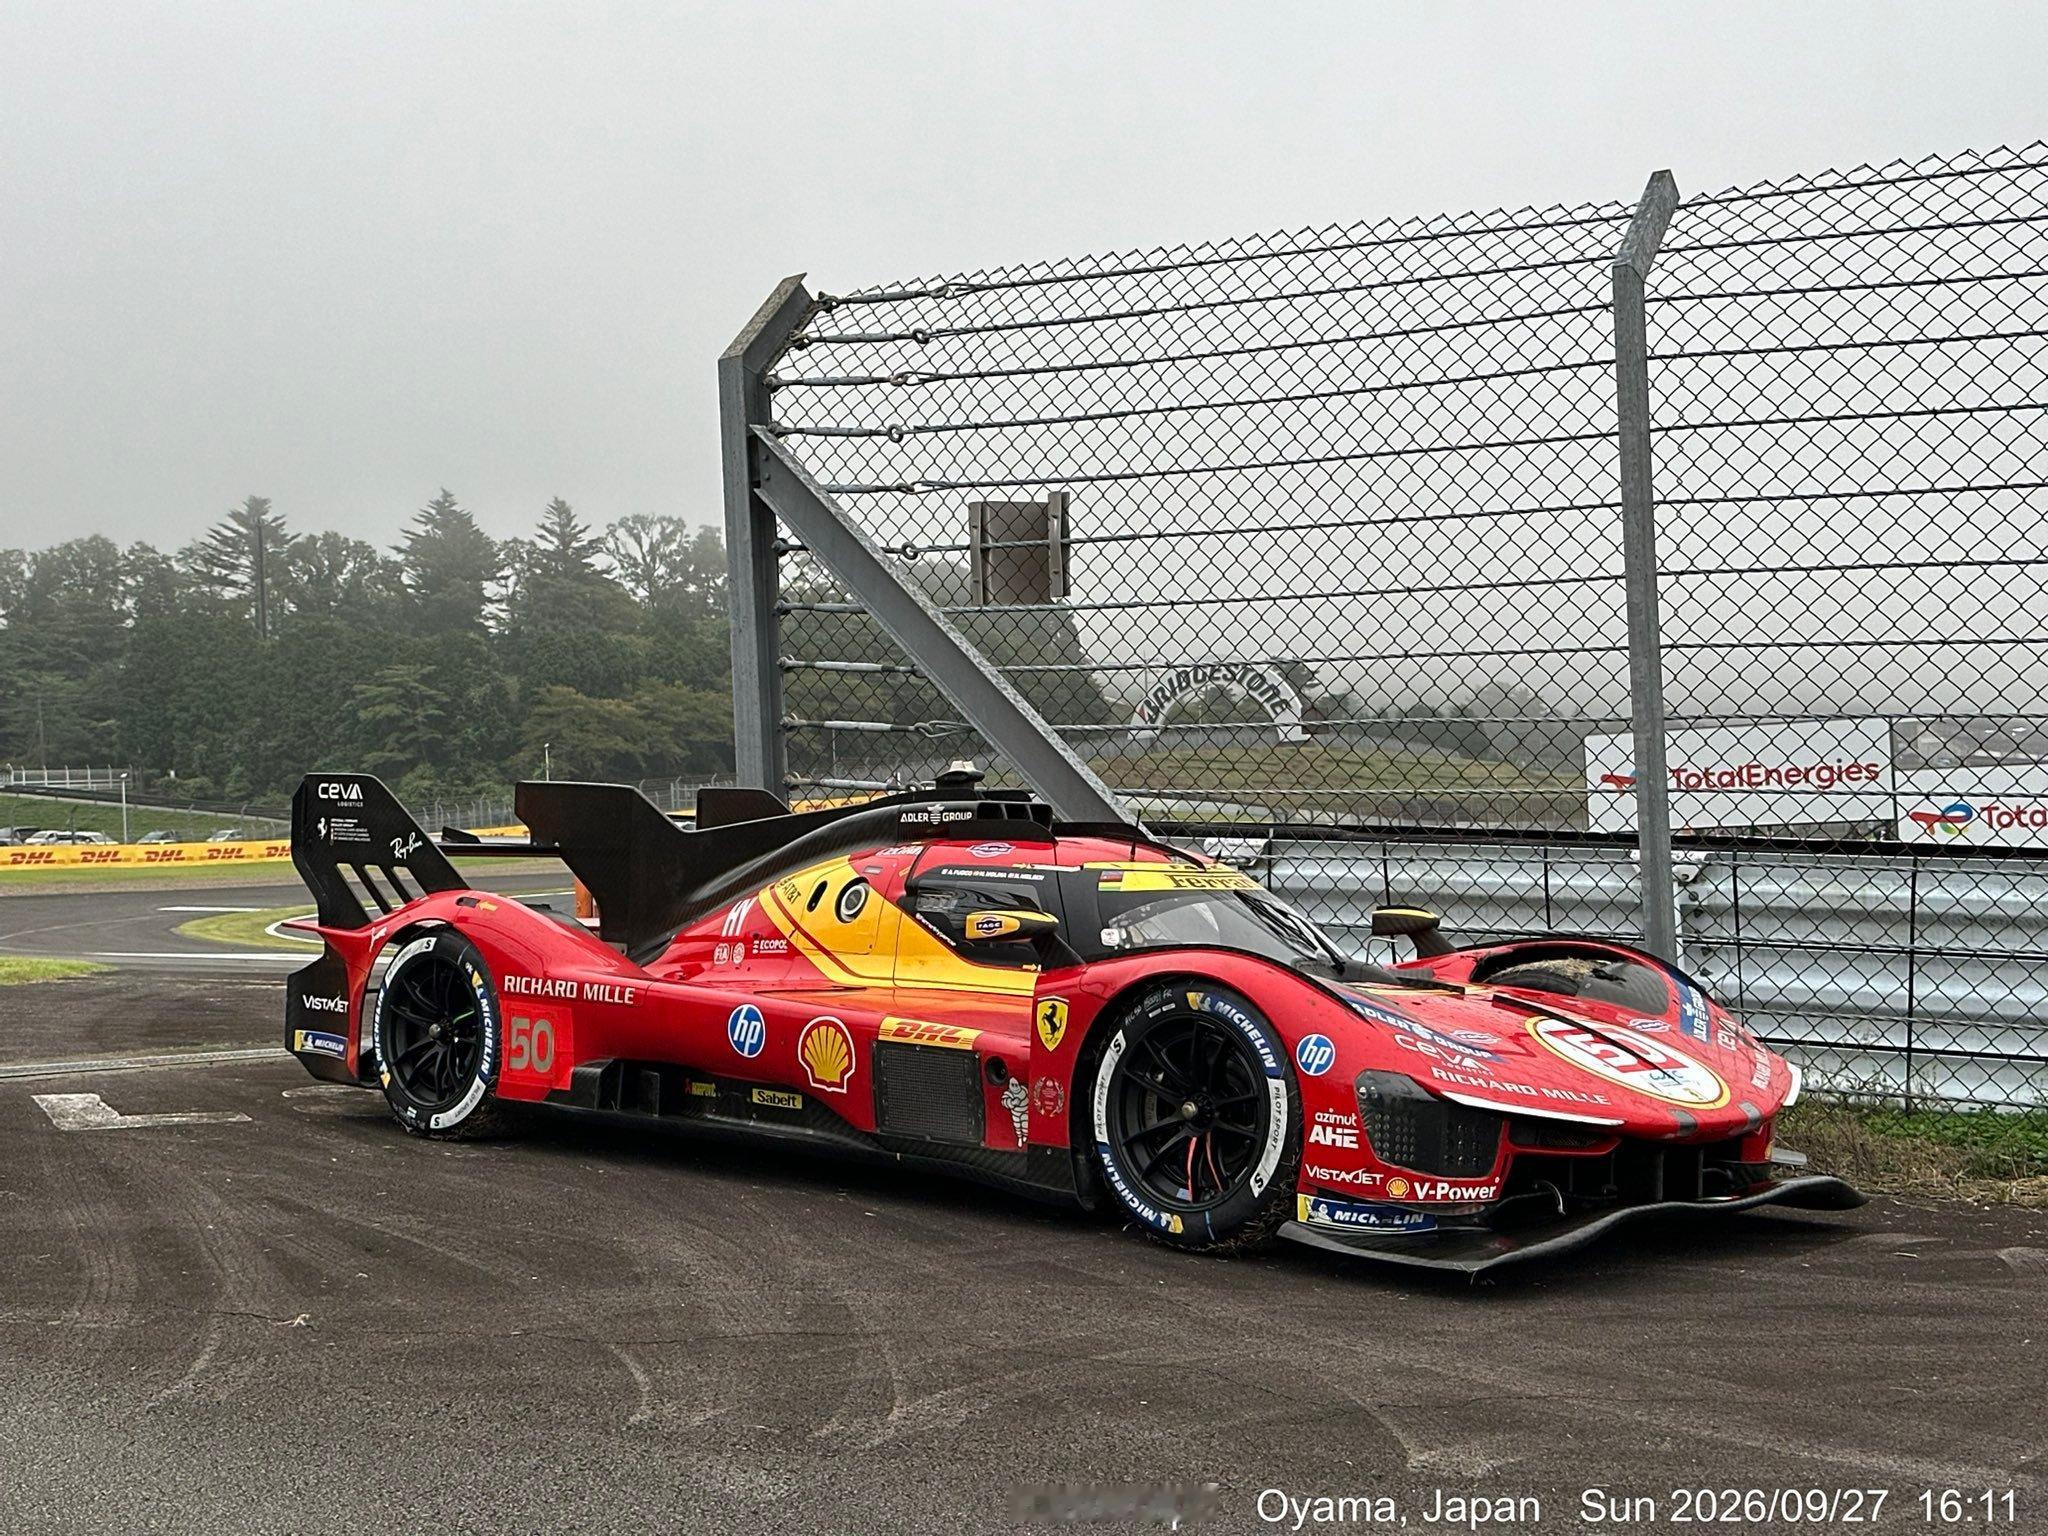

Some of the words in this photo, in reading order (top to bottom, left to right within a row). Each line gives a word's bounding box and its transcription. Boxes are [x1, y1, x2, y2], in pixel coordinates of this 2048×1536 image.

[1668, 758, 1880, 790] TotalEnergies
[900, 812, 929, 822] ADLER
[942, 812, 972, 822] GROUP
[10, 852, 56, 865] DHL
[80, 851, 122, 863] DHL
[145, 850, 186, 862] DHL
[207, 847, 245, 860] DHL
[265, 846, 291, 858] DH
[504, 975, 577, 998] RICHARD
[583, 982, 636, 1004] MILLE
[479, 998, 493, 1076] MICHELIN
[731, 1004, 763, 1057] hp
[891, 1021, 963, 1044] DHL
[1214, 1001, 1277, 1068] MICHELIN
[1351, 1003, 1411, 1032] ADLER
[1435, 1036, 1493, 1058] GROUP
[315, 1038, 345, 1052] MICHELIN
[509, 1016, 554, 1073] 50
[1114, 1039, 1122, 1053] S
[1300, 1034, 1332, 1075] hp
[1431, 1066, 1539, 1096] RICHARD
[1541, 1087, 1612, 1106] MILLE
[757, 1090, 797, 1107] Sabelt
[1274, 1086, 1282, 1116] PILOT
[433, 1116, 440, 1127] S
[1315, 1108, 1357, 1126] azimut
[1271, 1117, 1282, 1150] SPORT
[1101, 1153, 1157, 1223] MICHELIN
[1254, 1173, 1264, 1188] S
[1414, 1181, 1497, 1200] V-Power
